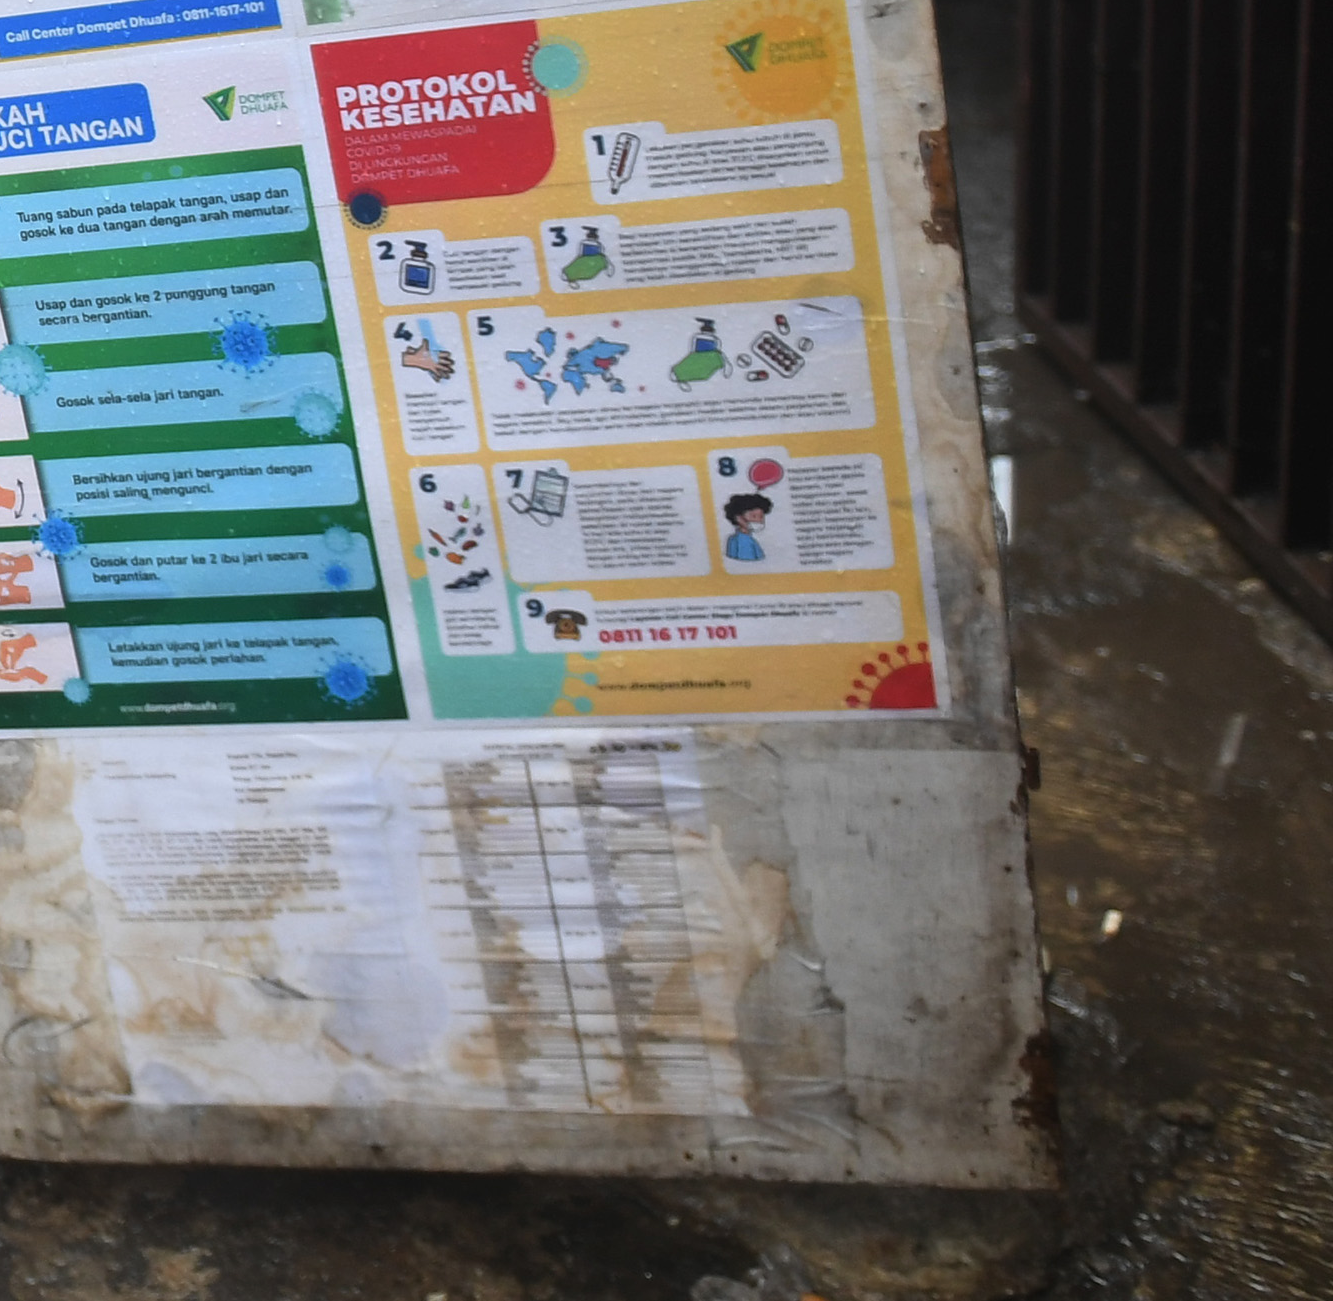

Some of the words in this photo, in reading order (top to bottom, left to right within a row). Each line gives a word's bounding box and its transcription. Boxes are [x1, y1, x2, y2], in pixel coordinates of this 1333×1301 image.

[5, 29, 31, 43] Call
[31, 26, 75, 40] Center
[76, 18, 128, 35] Dompet
[128, 12, 175, 28] Dhuafa
[238, 90, 286, 105] DOMPET
[335, 69, 517, 109] PROTOKOL
[240, 101, 289, 115] DHUAFA
[339, 90, 537, 132] KESEHATAN
[37, 116, 144, 146] TANGAN
[591, 134, 606, 156] 1
[15, 211, 54, 224] Tuang
[56, 207, 94, 220] sabun
[96, 202, 127, 219] pada
[129, 197, 177, 213] telapak
[179, 195, 228, 209] tangan,
[229, 191, 262, 204] usap
[264, 187, 290, 200] dan
[19, 225, 57, 242] gosok
[58, 224, 75, 235] ke
[77, 222, 101, 234] dua
[102, 219, 147, 232] tangan
[149, 214, 197, 228] dengan
[199, 209, 230, 223] arah
[232, 205, 293, 219] memutar.
[549, 226, 568, 248] 3
[376, 240, 396, 261] 2
[34, 299, 67, 312] Usap
[69, 297, 93, 309] dan
[95, 293, 133, 309] gosok
[134, 292, 151, 303] ke
[152, 290, 162, 302] 2
[163, 286, 228, 303] punggung
[230, 282, 276, 296] tangan
[38, 315, 80, 327] secara
[81, 308, 152, 324] bergantian.
[477, 316, 494, 336] 5
[393, 321, 414, 342] 4
[55, 395, 95, 408] Gosok
[97, 391, 152, 406] sela-sela
[153, 389, 175, 404] jari
[177, 388, 224, 401] tangan.
[72, 472, 134, 486] Bersihkan
[135, 471, 171, 484] ujung
[172, 469, 194, 483] jari
[195, 466, 263, 480] bergantian
[265, 464, 313, 477] dengan
[718, 456, 737, 477] 8
[419, 473, 437, 493] 6
[506, 469, 523, 489] 7
[75, 488, 111, 503] posisi
[112, 486, 152, 501] saling
[150, 483, 214, 498] mengunci.
[525, 599, 544, 618] 9
[598, 628, 643, 644] 0811
[648, 627, 672, 642] 16
[677, 626, 699, 641] 17
[705, 625, 737, 640] 101
